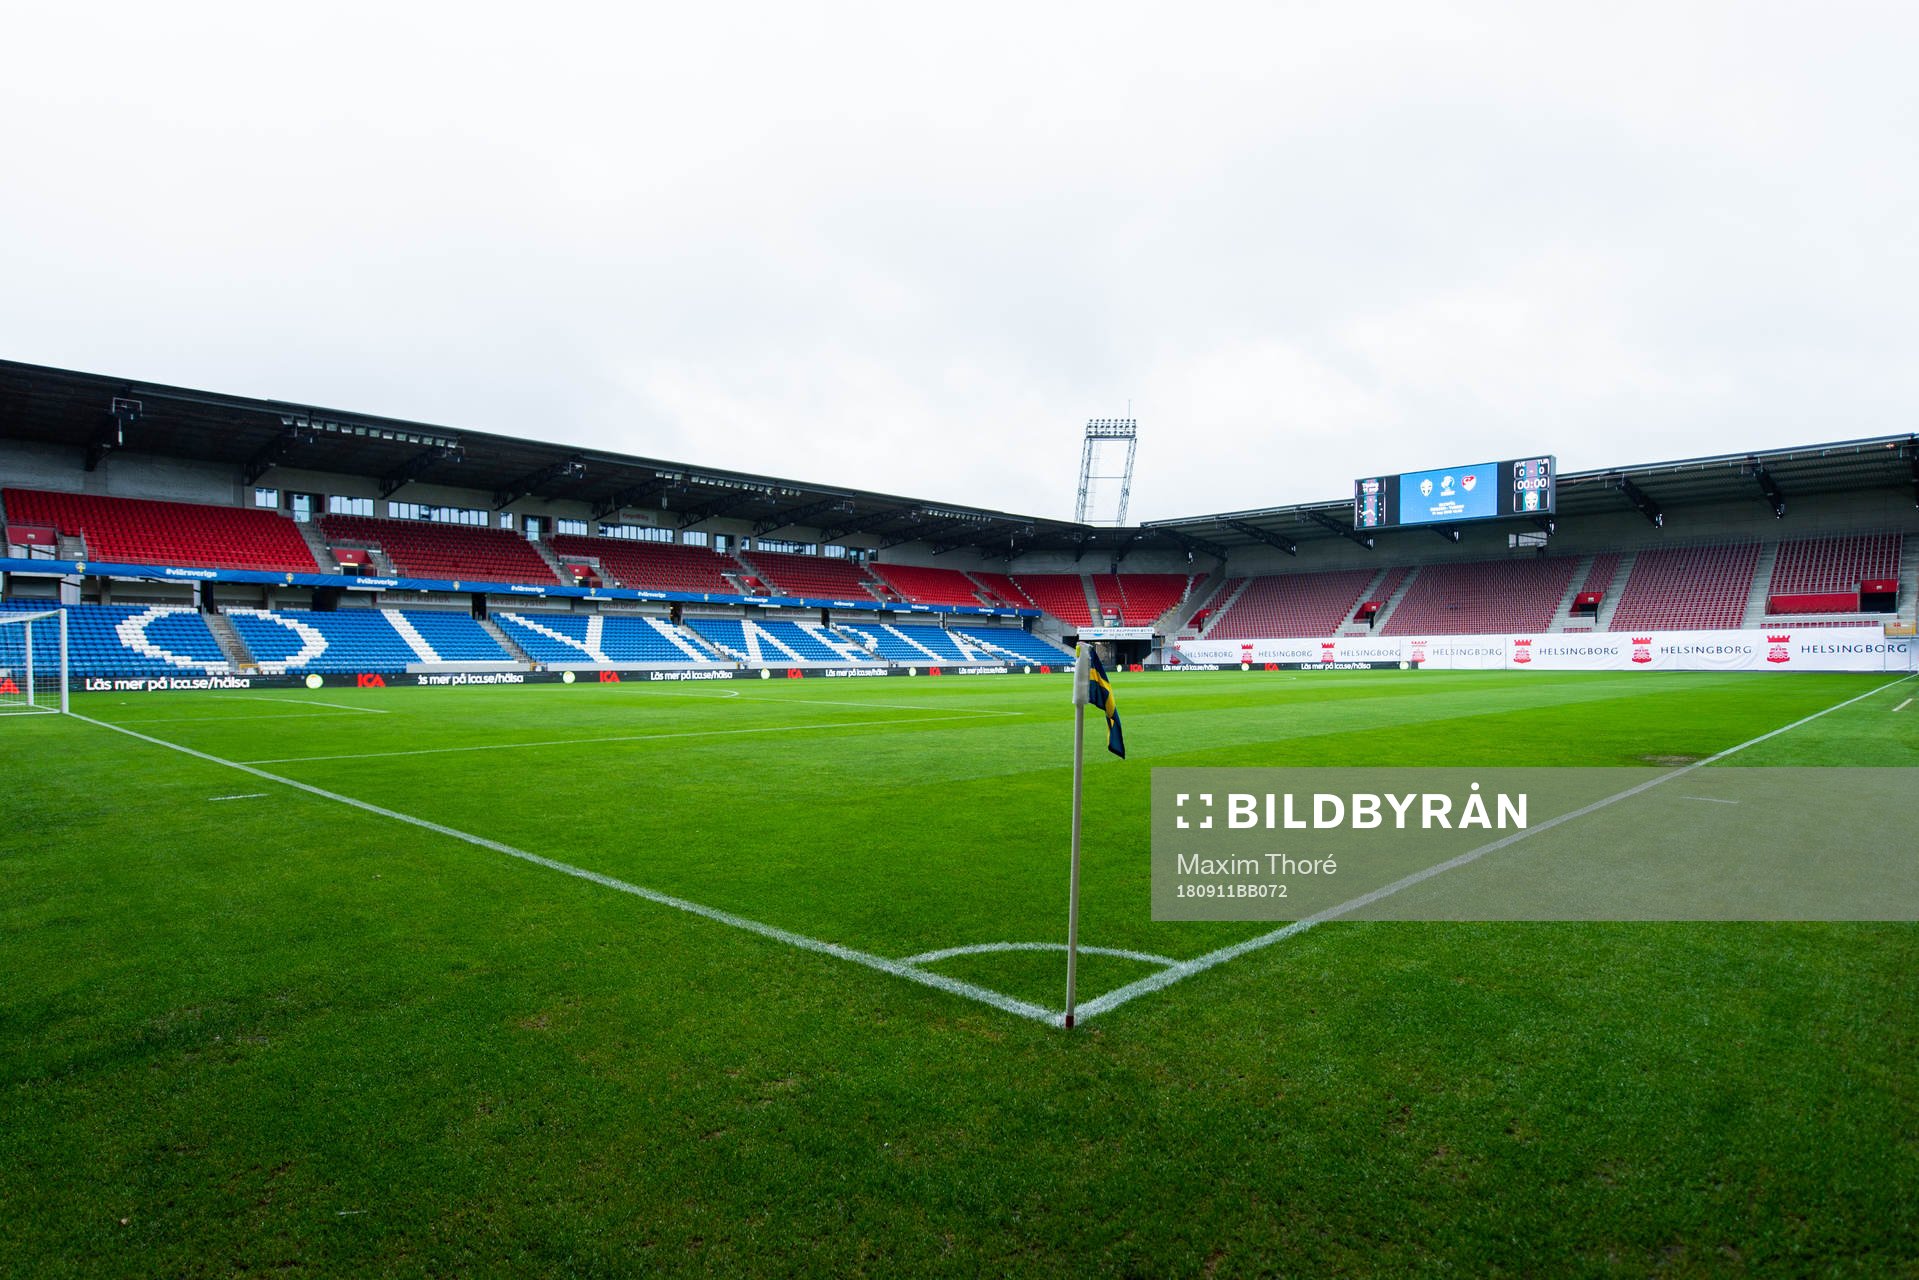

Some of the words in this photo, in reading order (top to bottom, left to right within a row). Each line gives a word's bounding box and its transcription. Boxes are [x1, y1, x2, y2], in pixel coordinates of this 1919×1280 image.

[1519, 468, 1525, 476] 0
[1539, 466, 1545, 474] 0
[1517, 478, 1547, 490] 00:00
[1432, 648, 1502, 656] HELSINGBORG
[1539, 647, 1619, 655] HELSINGBORG
[1660, 645, 1752, 654] HELSINGBORG
[1801, 643, 1908, 653] HELSINGBORG
[1185, 650, 1233, 658] HELSINGBORG
[1258, 649, 1313, 657] HELSINGBORG
[1340, 649, 1401, 657] HELSINGBORG
[1040, 665, 1051, 674] ICA
[1129, 664, 1143, 672] ICA
[1264, 662, 1279, 671] ICA
[650, 671, 664, 680] Läs
[665, 672, 680, 680] mer
[681, 670, 691, 681] på
[787, 668, 803, 679] ICA
[929, 667, 942, 676] ICA
[357, 673, 386, 687] ICA
[430, 676, 450, 685] mer
[452, 673, 466, 686] på
[600, 670, 620, 683] ICA
[86, 678, 112, 690] Läs
[115, 680, 145, 690] mer
[148, 676, 167, 692] på
